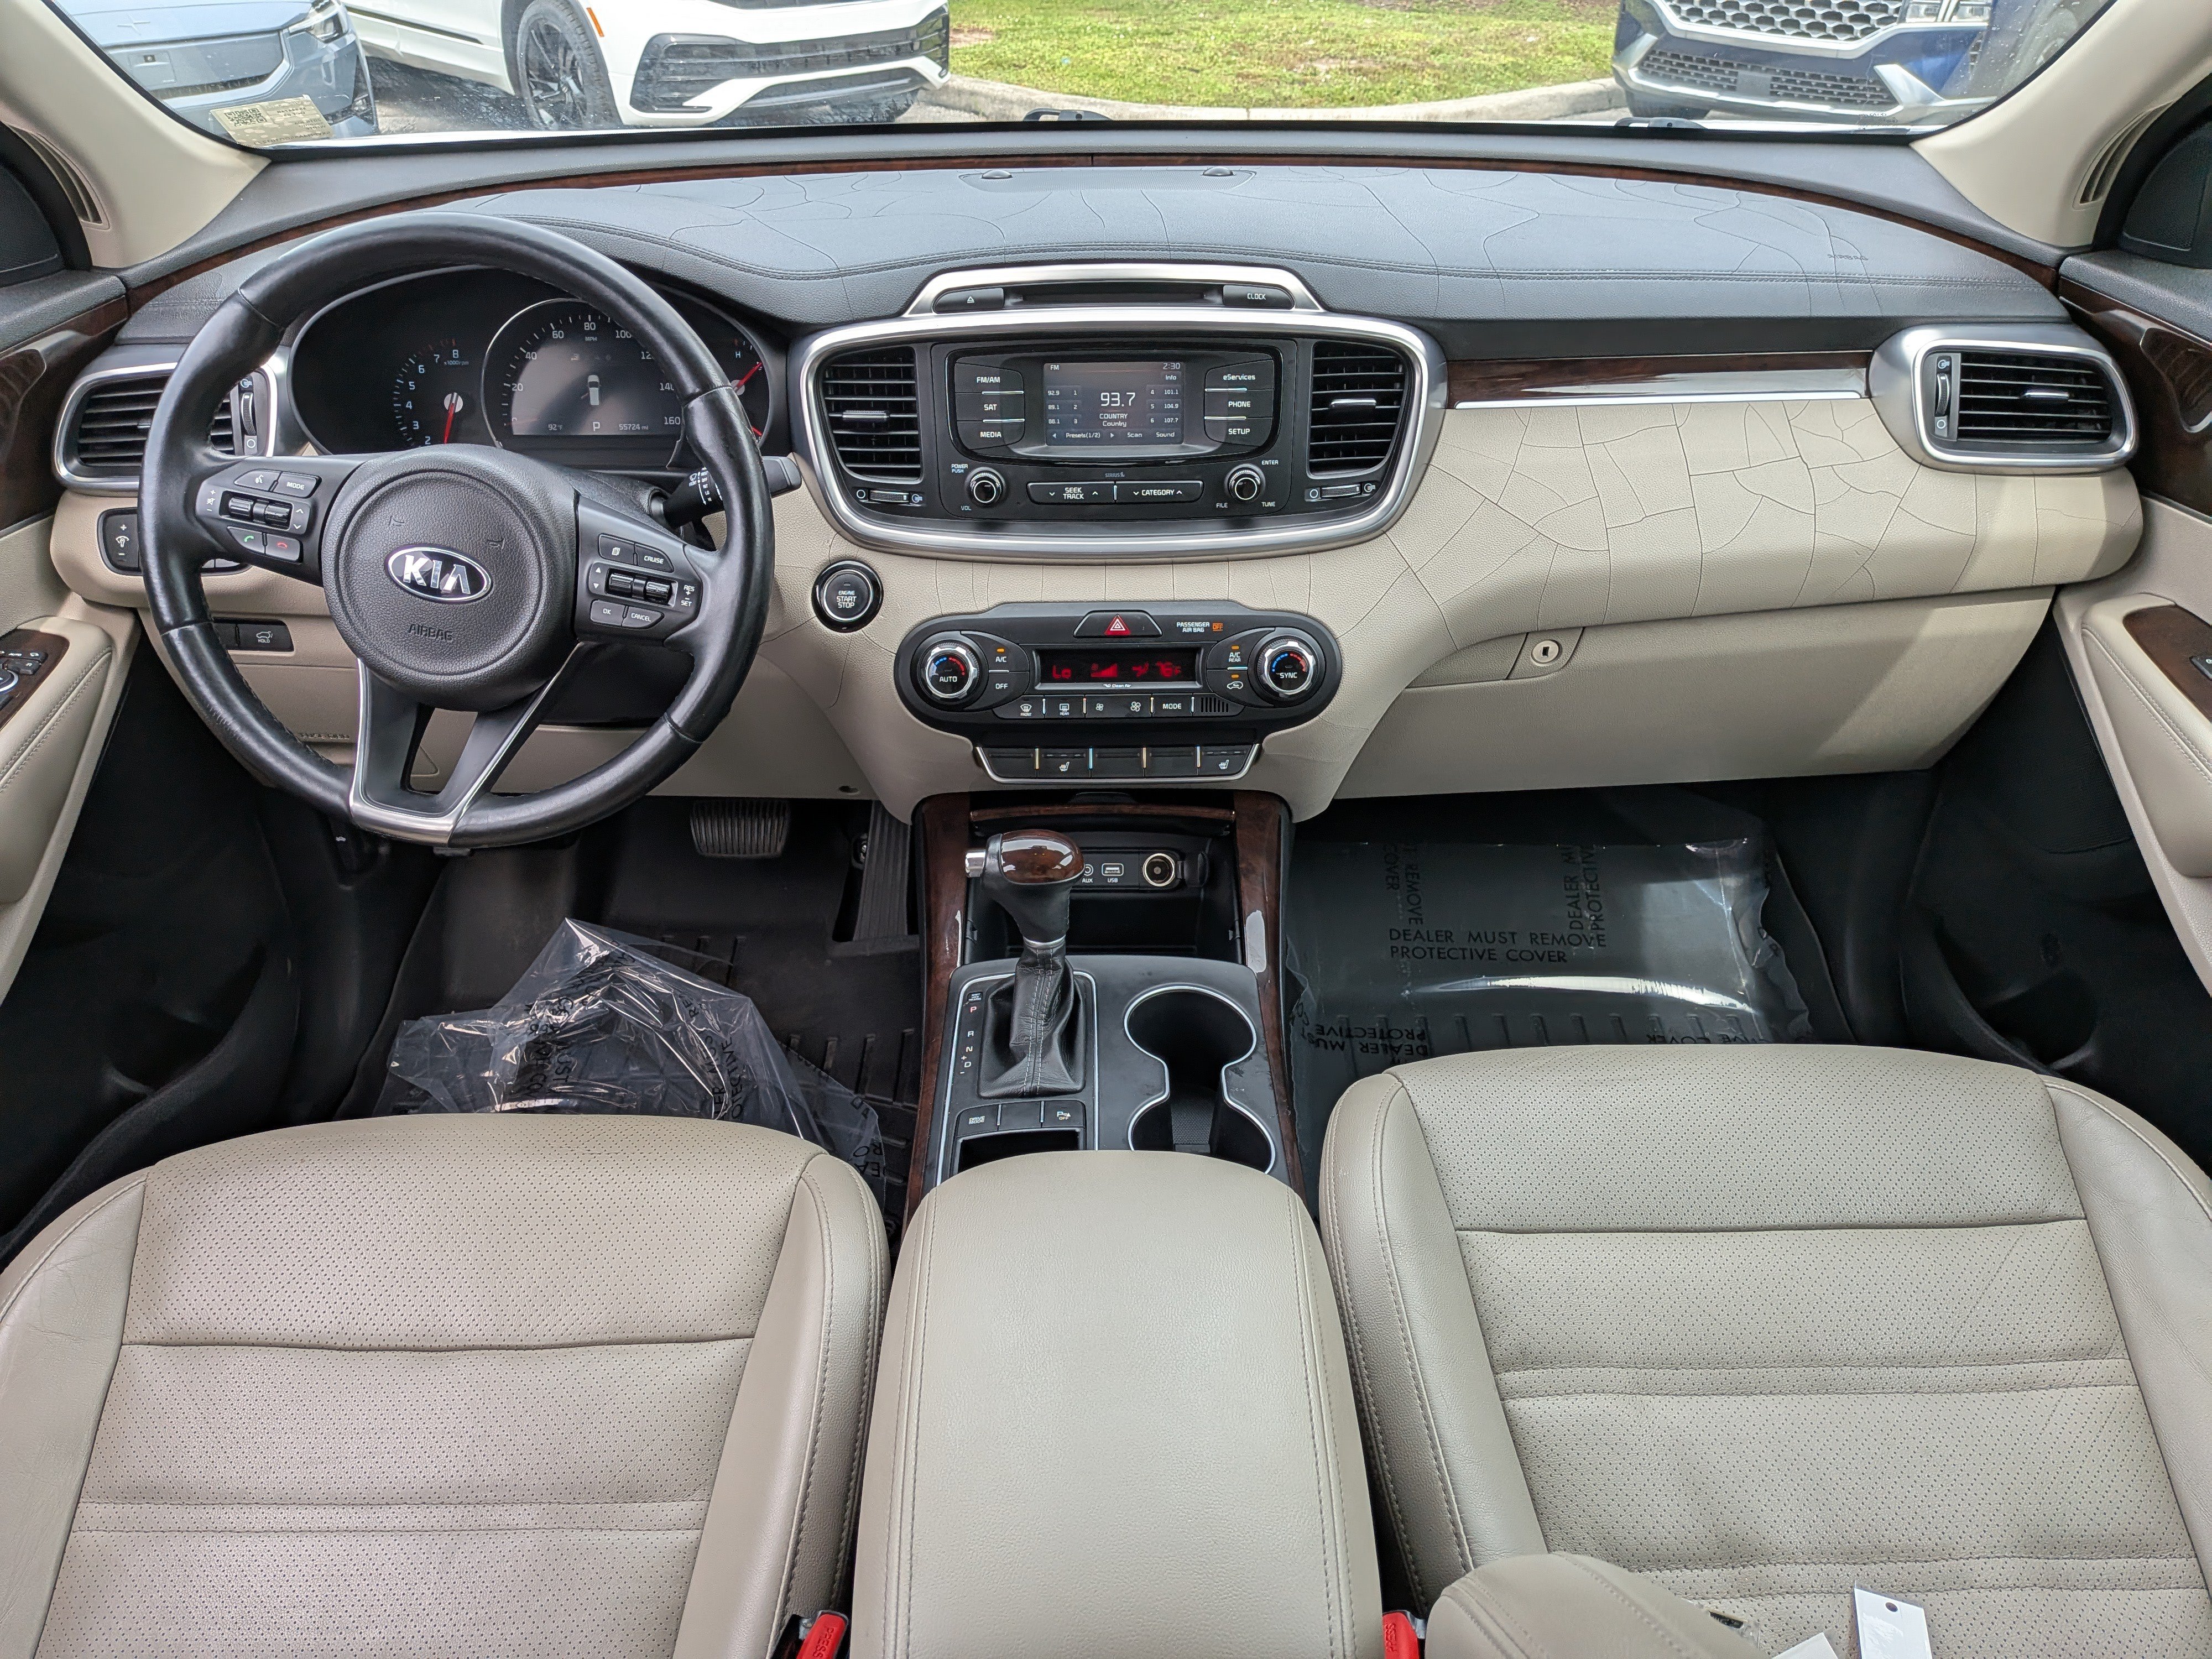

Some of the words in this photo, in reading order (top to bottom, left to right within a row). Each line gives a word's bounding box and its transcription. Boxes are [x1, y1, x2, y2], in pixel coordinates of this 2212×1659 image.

[583, 322, 596, 331] 80
[552, 331, 564, 339] 60
[452, 349, 459, 358] 8
[525, 351, 537, 360] 40
[641, 351, 654, 359] 12
[434, 354, 440, 363] 7
[418, 364, 425, 374] 6
[409, 381, 415, 390] 5
[512, 383, 524, 392] 20
[1100, 392, 1136, 407] 93.7
[405, 401, 413, 410] 4
[664, 416, 681, 425] 160
[413, 421, 419, 430] 3
[593, 421, 601, 432] P
[425, 436, 431, 445] 2
[286, 481, 305, 491] MODE
[644, 555, 664, 565] CRUISE
[403, 555, 471, 595] KIA
[836, 595, 858, 603] START
[630, 612, 652, 623] CANCEL
[409, 623, 453, 641] AIRBAG
[1580, 845, 1605, 931] PROTECTIV
[1389, 928, 1454, 943] DEALER
[1468, 931, 1518, 945] MUST
[1529, 932, 1607, 947] REMOVE
[1390, 945, 1498, 961] PROTECTIVE
[1505, 948, 1567, 963] COVER
[721, 1036, 744, 1120] OTECTIVE
